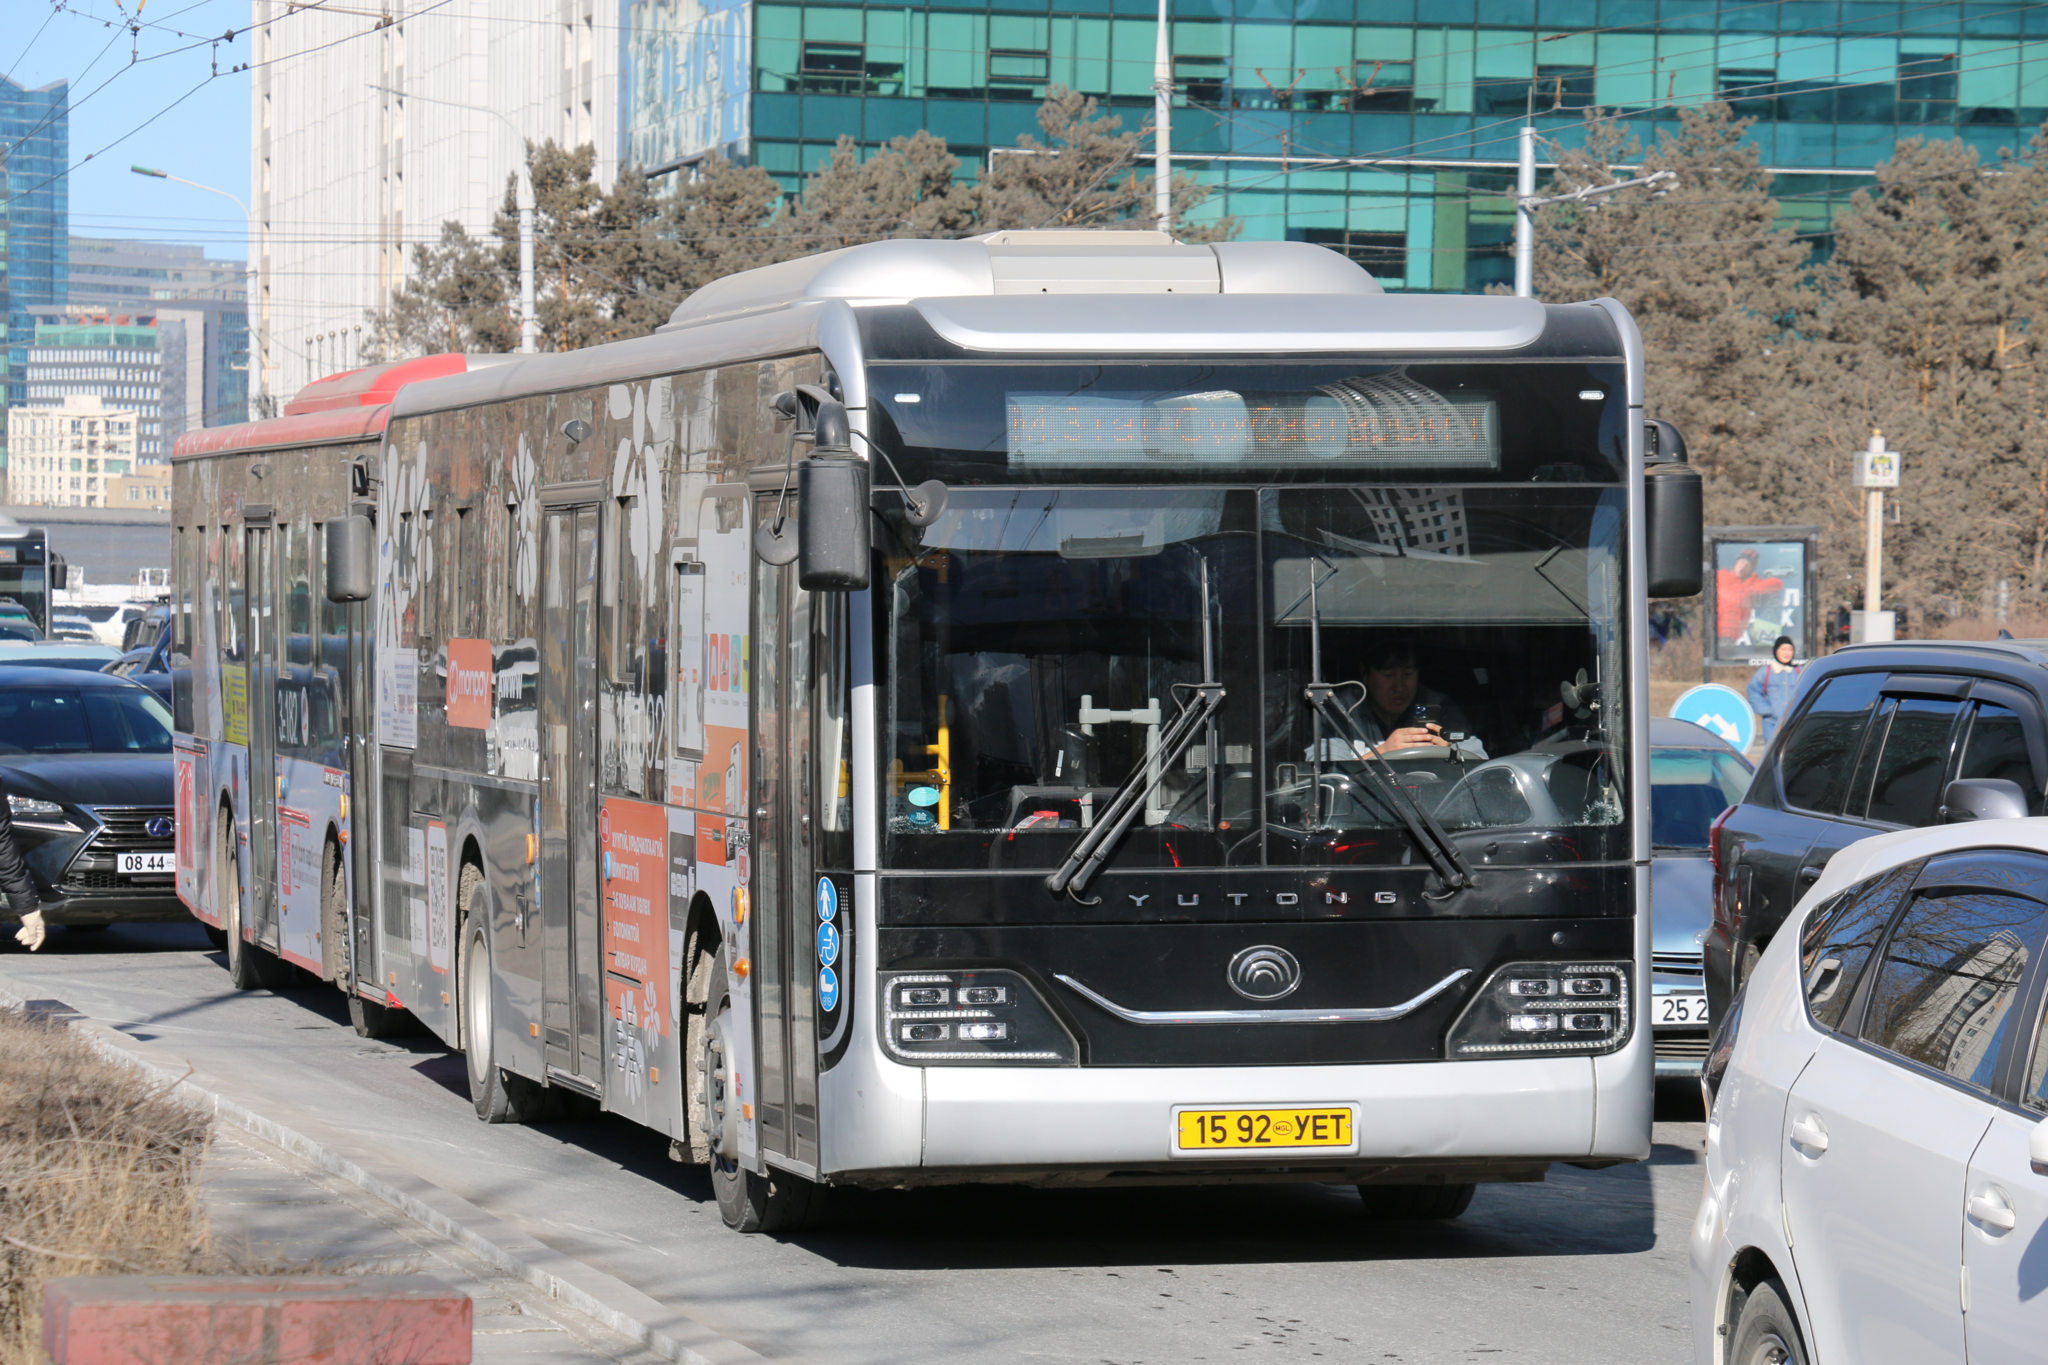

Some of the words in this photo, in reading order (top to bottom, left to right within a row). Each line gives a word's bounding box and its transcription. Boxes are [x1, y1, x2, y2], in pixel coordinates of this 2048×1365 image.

[458, 669, 489, 705] monpay
[125, 855, 143, 871] 08
[147, 855, 165, 870] 44
[1128, 892, 1397, 907] YUTONG
[1662, 998, 1689, 1021] 25
[1196, 1115, 1227, 1144] 15
[1236, 1114, 1272, 1143] 92
[1274, 1124, 1290, 1132] MGL
